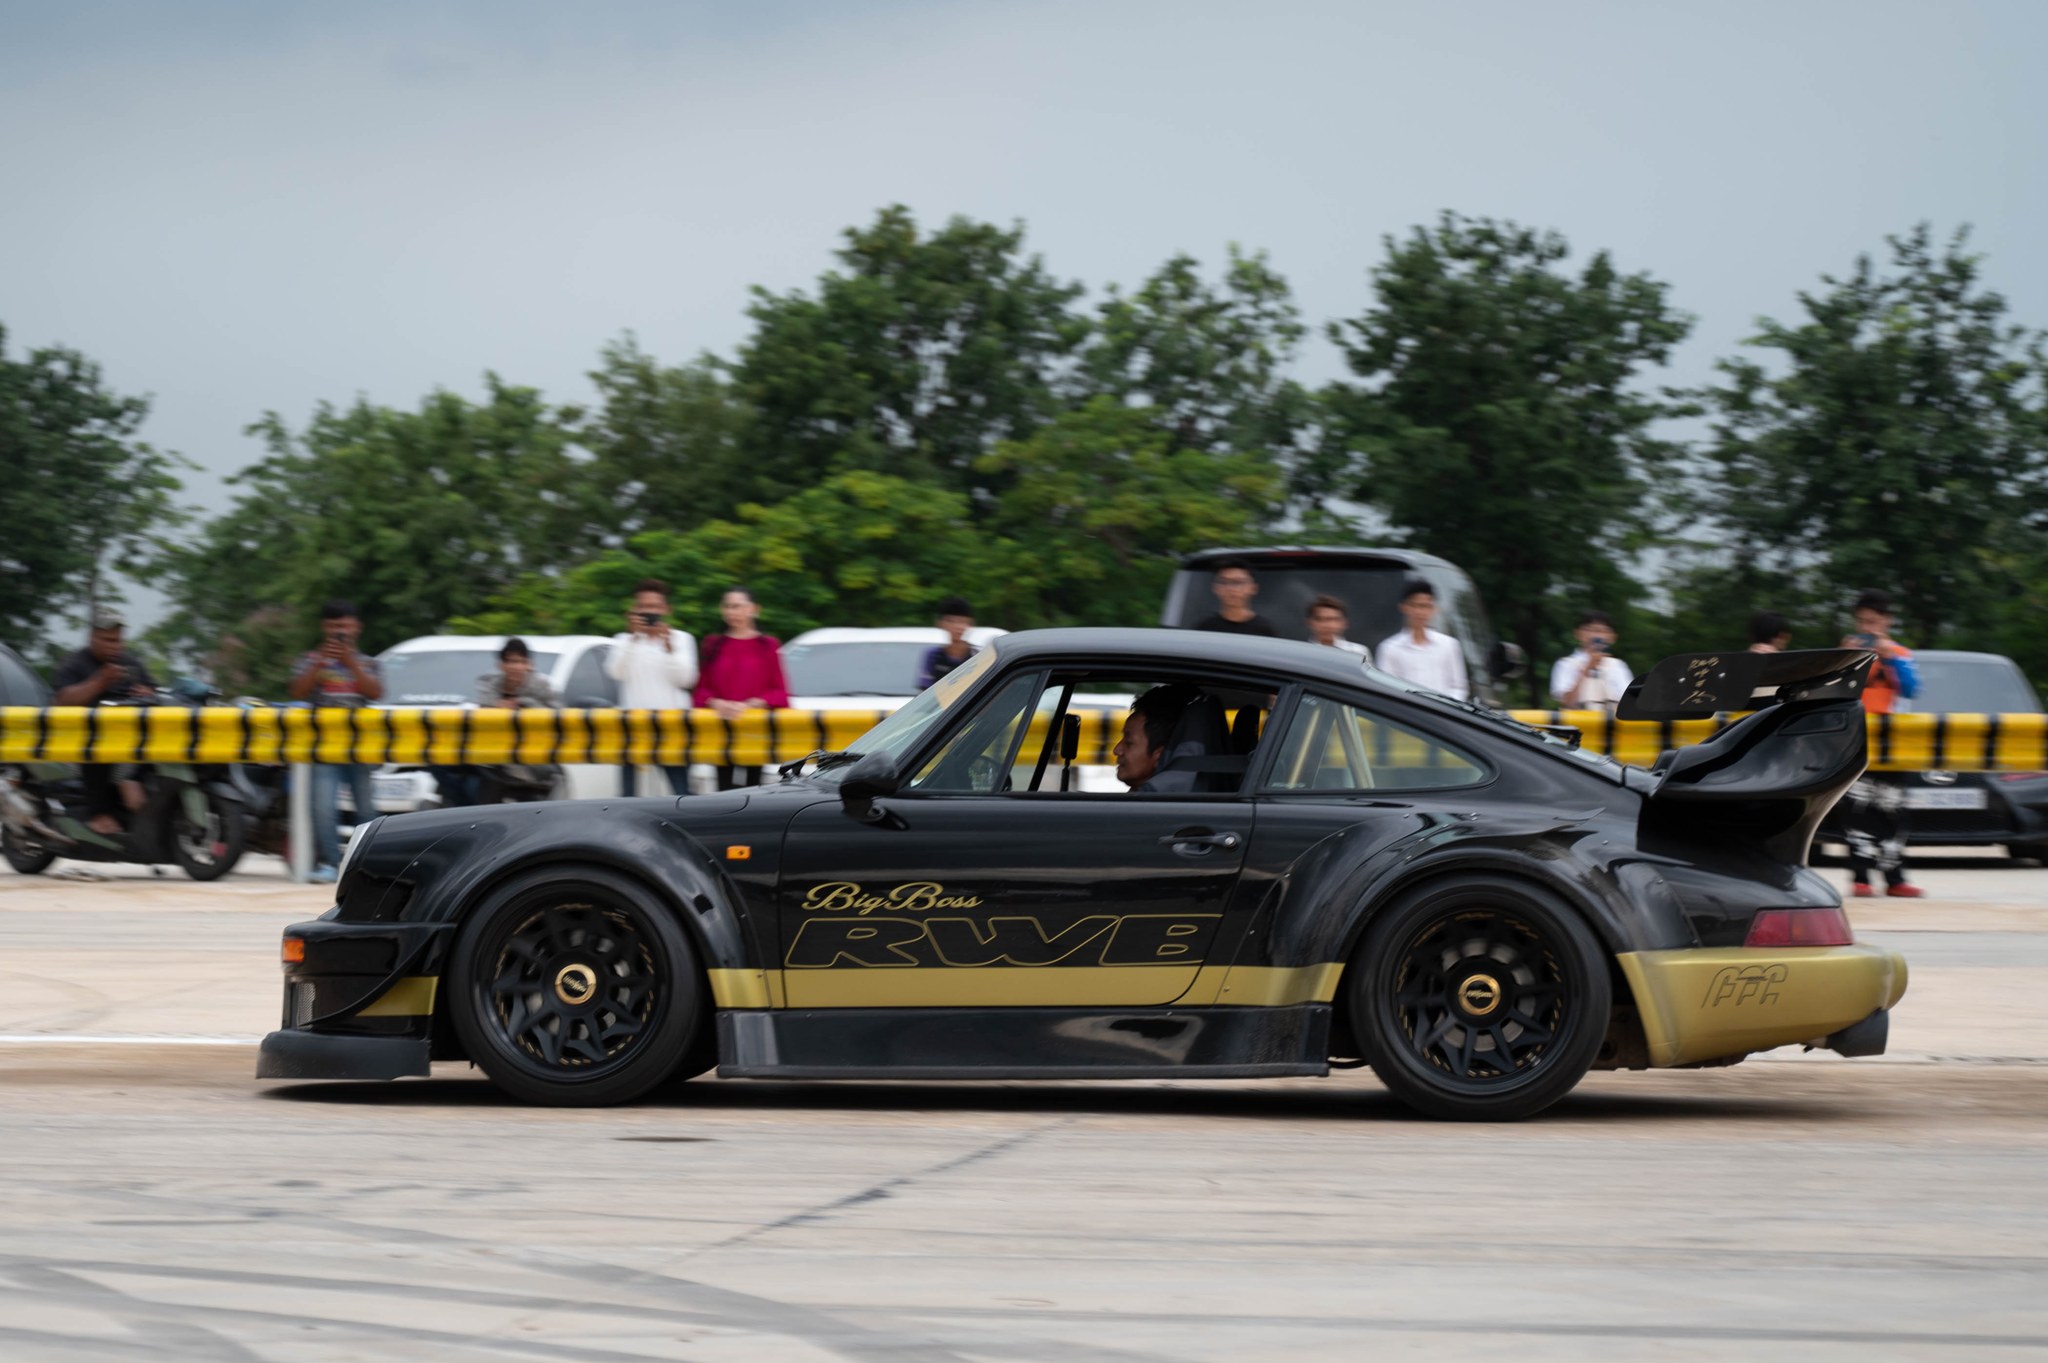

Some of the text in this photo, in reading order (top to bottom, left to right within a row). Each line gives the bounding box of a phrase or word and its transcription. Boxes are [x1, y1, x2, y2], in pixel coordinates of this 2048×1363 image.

[801, 881, 984, 916] Big Boss
[784, 914, 1223, 967] RWB
